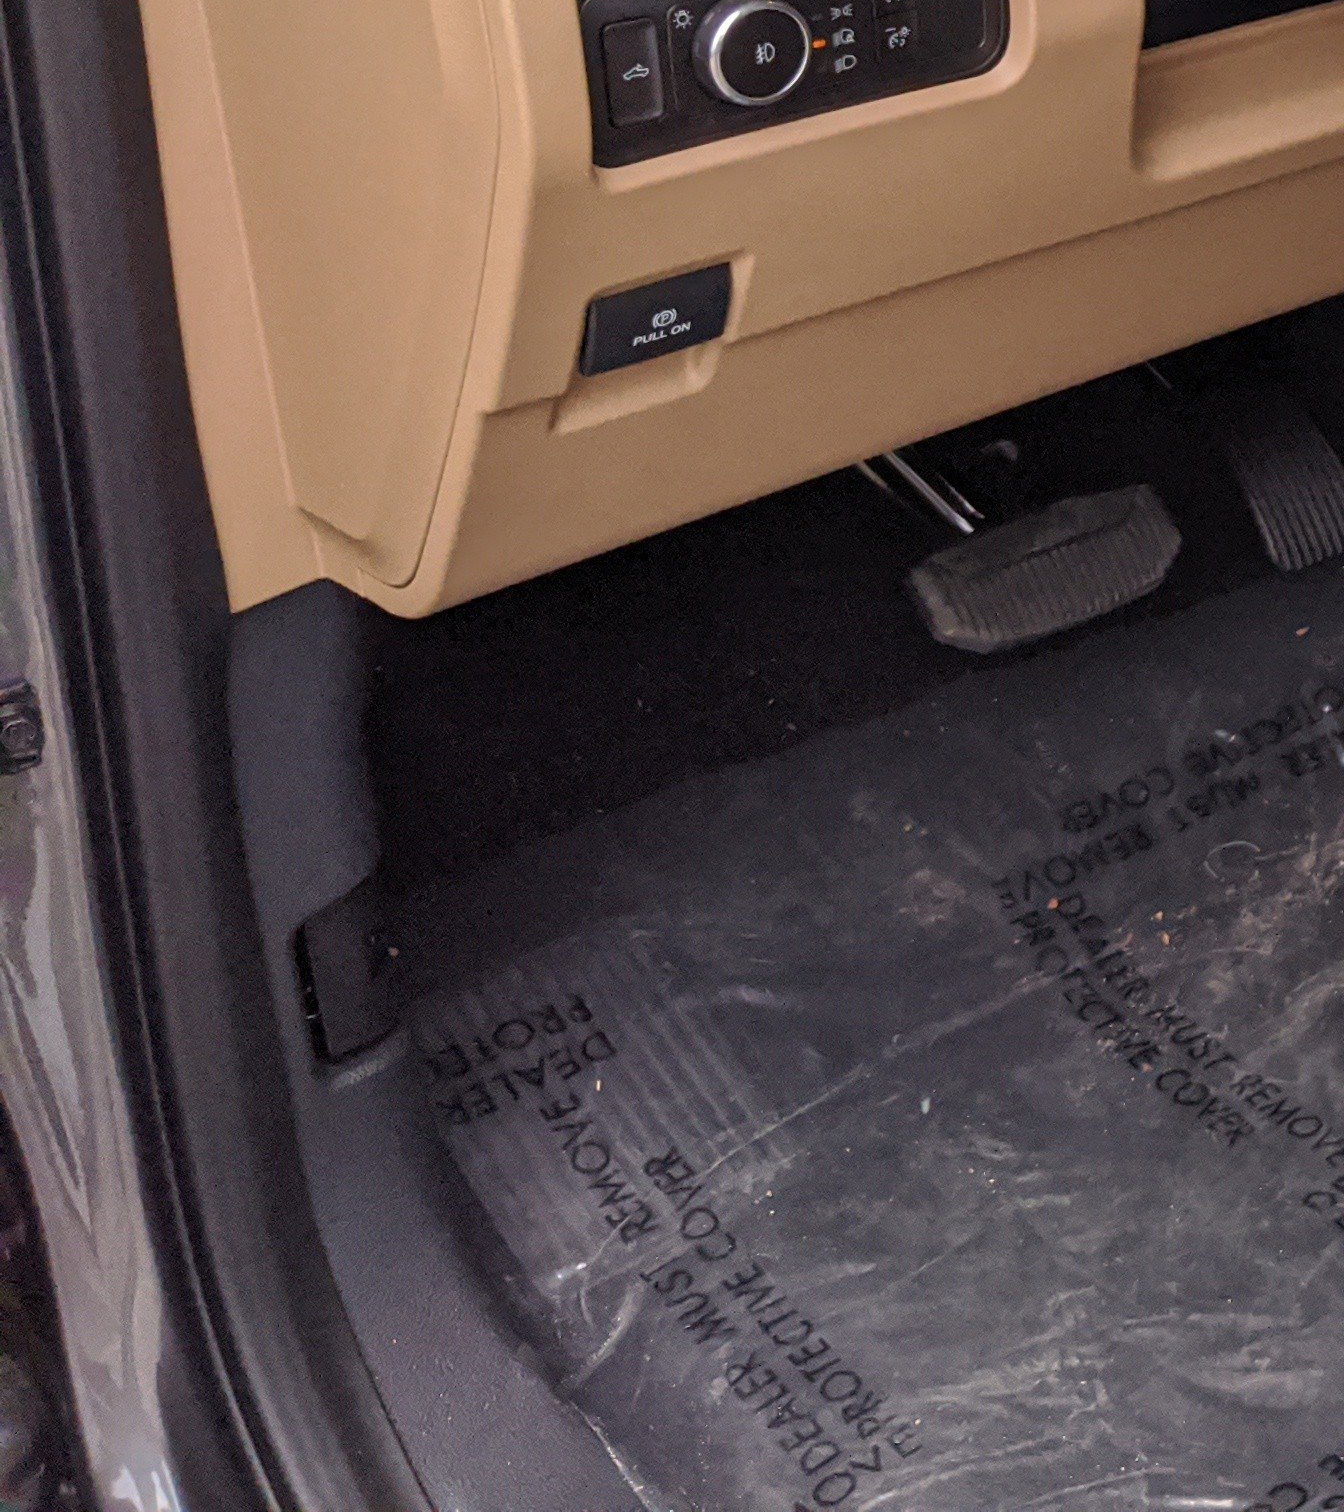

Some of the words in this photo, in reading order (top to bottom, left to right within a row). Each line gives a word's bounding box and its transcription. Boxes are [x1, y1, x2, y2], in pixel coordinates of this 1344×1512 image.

[632, 330, 668, 347] PULL
[670, 321, 692, 336] ON
[1145, 1005, 1238, 1070] MUST
[539, 1092, 660, 1244] REMOVE
[643, 1145, 737, 1261] COVER
[639, 1256, 738, 1345] MUST
[722, 1262, 897, 1439] PROTECTIVE
[725, 1352, 842, 1477] DEALER
